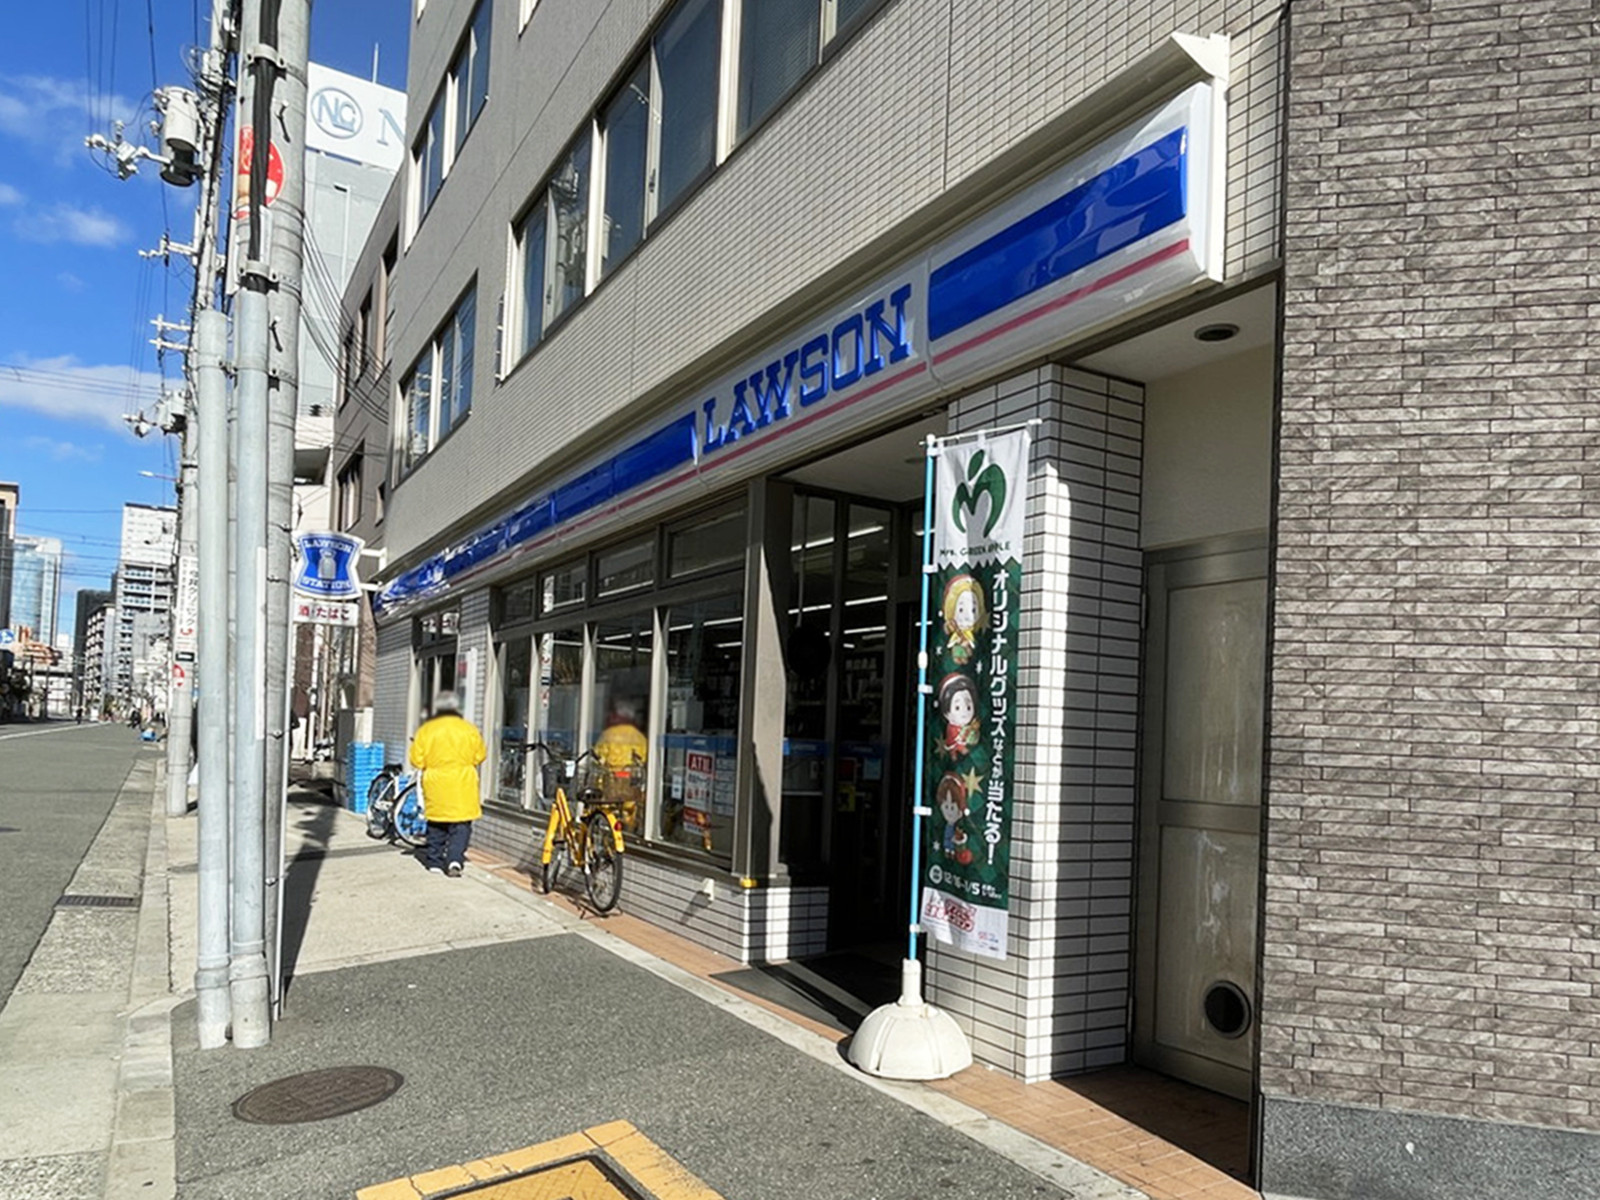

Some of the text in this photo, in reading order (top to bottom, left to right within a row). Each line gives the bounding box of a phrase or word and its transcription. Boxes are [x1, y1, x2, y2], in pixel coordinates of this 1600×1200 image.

[703, 284, 912, 454] LAWSON
[303, 539, 353, 553] LAWSON
[301, 576, 353, 589] STATION
